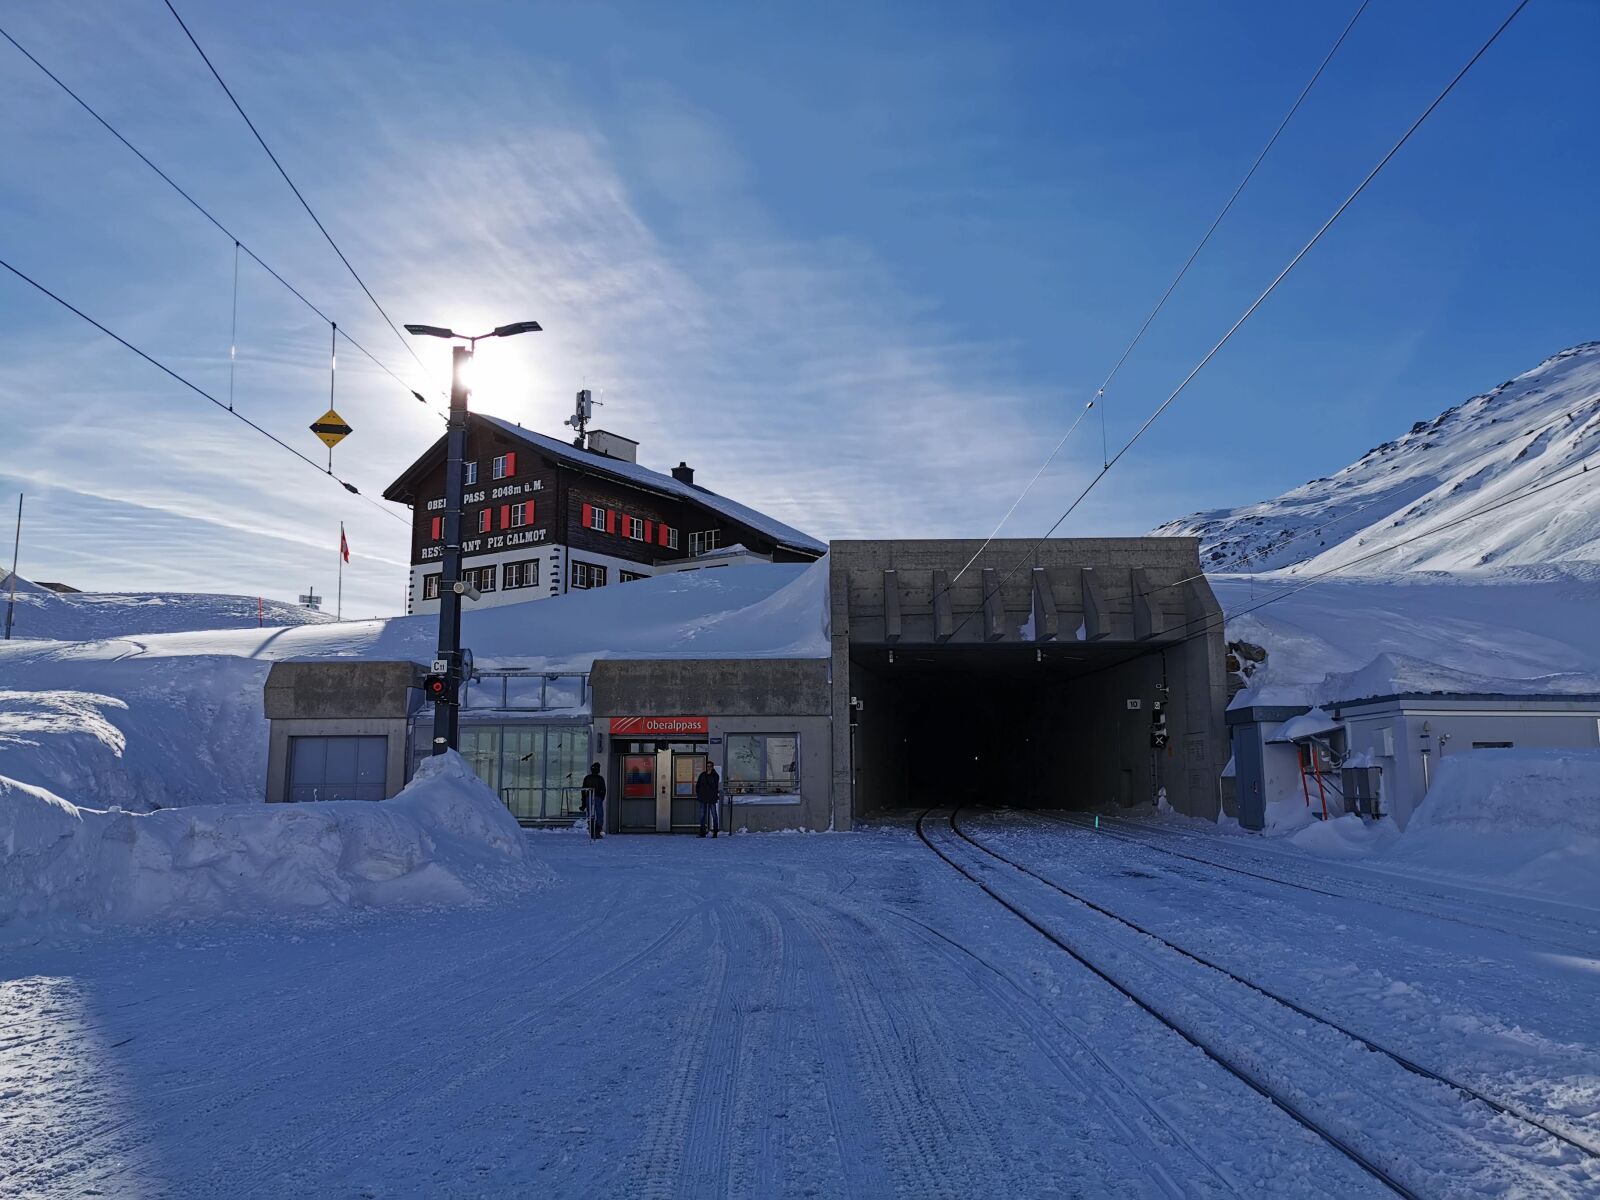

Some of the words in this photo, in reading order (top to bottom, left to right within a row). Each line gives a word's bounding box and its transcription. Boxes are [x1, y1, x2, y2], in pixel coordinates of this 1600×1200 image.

[492, 485, 521, 499] 2048m
[421, 540, 481, 559] RESANT
[487, 536, 504, 549] PIZ
[506, 529, 546, 546] CALMOT
[646, 719, 702, 731] Oberalppass
